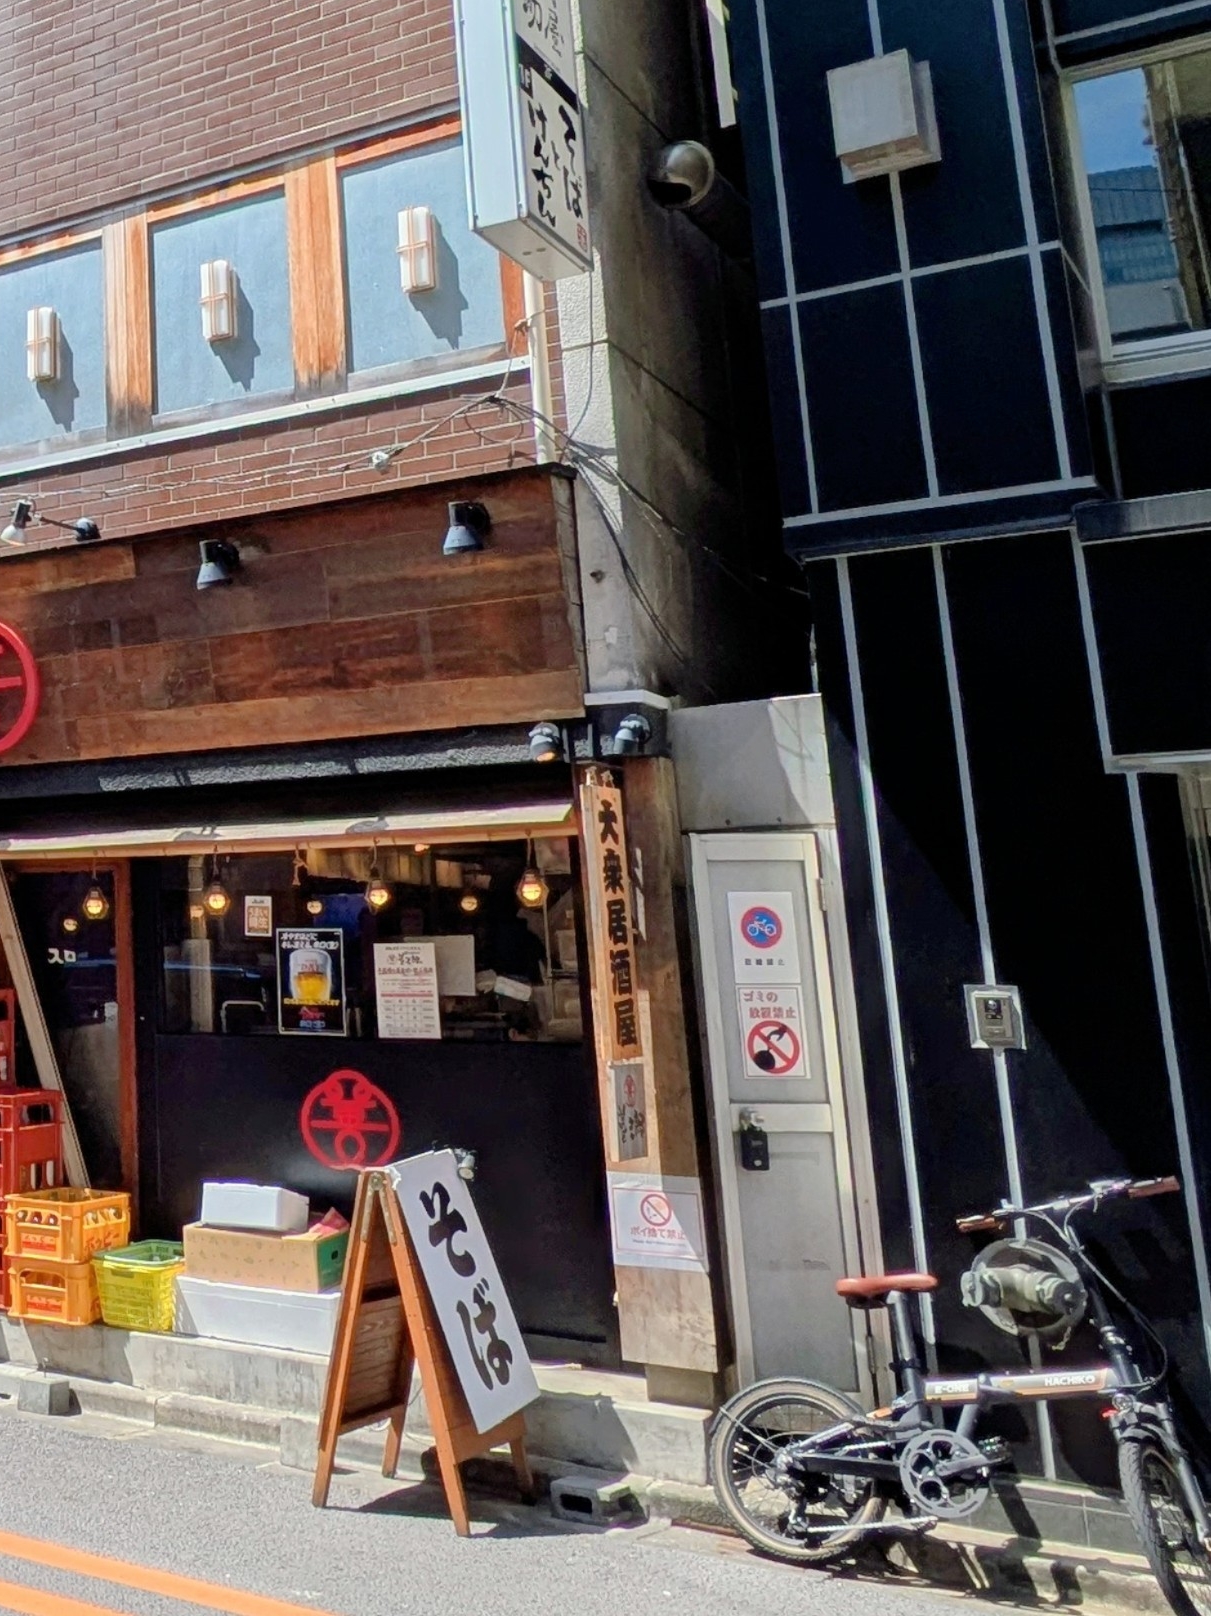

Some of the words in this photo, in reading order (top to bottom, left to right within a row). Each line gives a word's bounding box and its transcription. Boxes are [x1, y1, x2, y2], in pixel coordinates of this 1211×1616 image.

[597, 798, 639, 1047] 大衆居酒屋
[742, 990, 779, 1003] ゴミの
[418, 1181, 514, 1391] そば
[630, 1225, 686, 1241] ポイ捨て禁止
